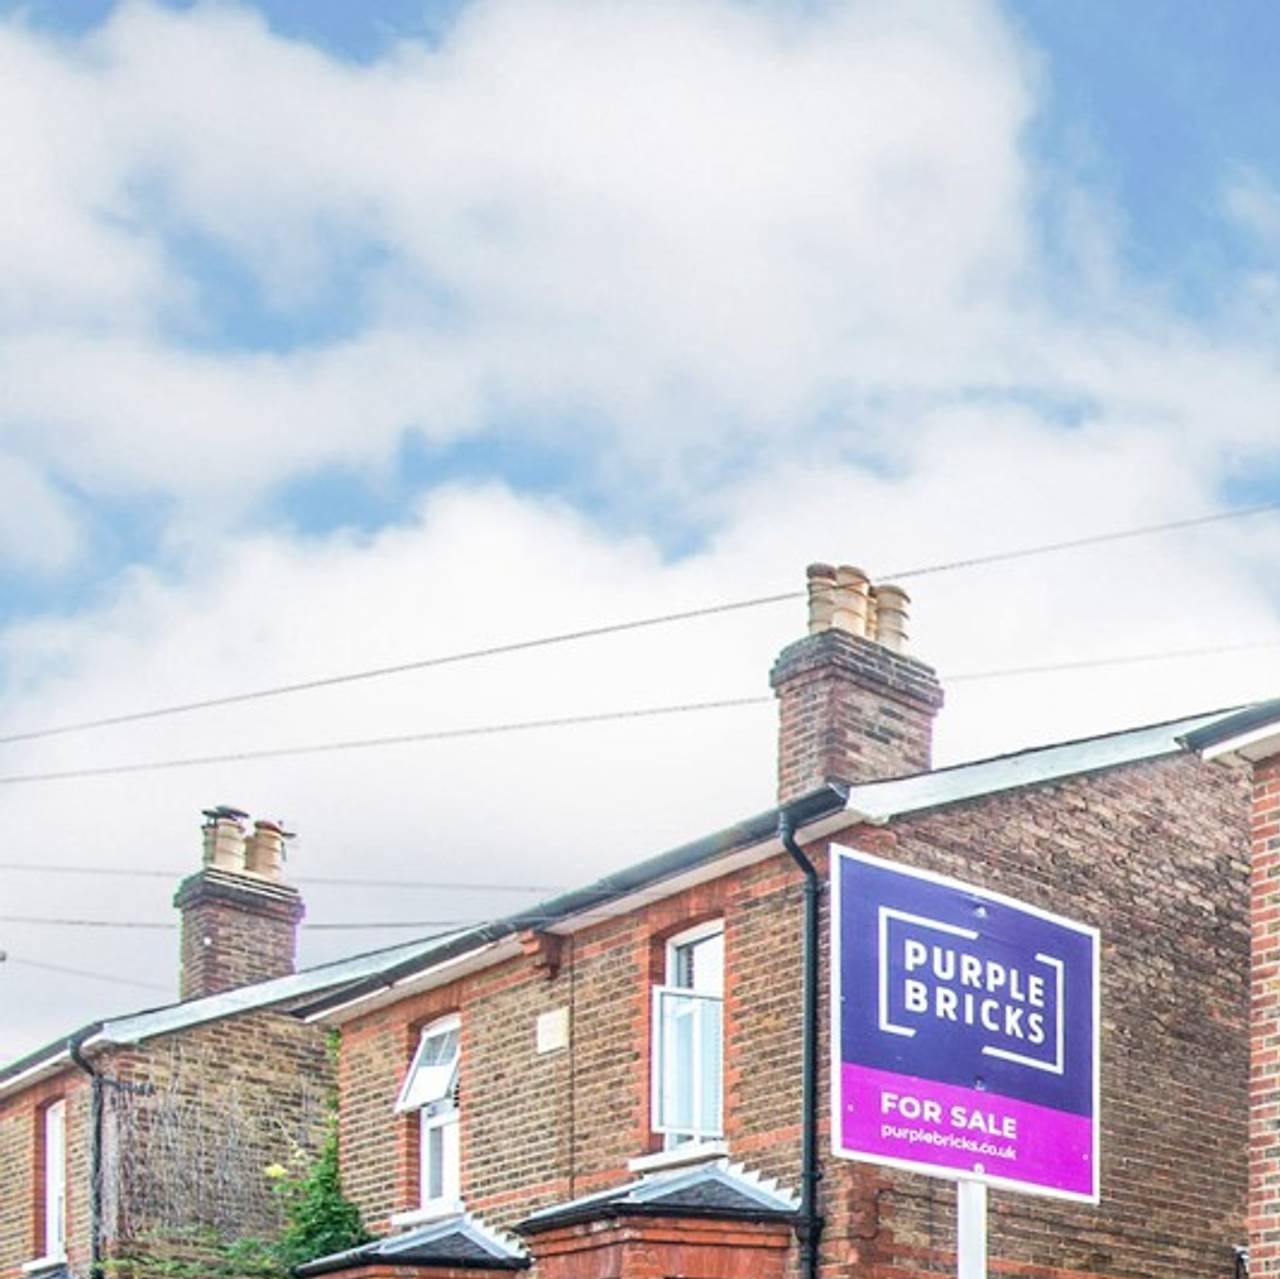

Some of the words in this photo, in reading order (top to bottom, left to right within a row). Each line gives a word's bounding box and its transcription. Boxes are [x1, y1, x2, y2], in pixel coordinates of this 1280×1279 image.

[905, 939, 1044, 1007] PURPLE
[905, 979, 1045, 1044] BRICKS
[881, 1091, 942, 1123] FOR
[950, 1105, 1017, 1139] SALE
[881, 1125, 1017, 1160] purplebricks.co.uk
